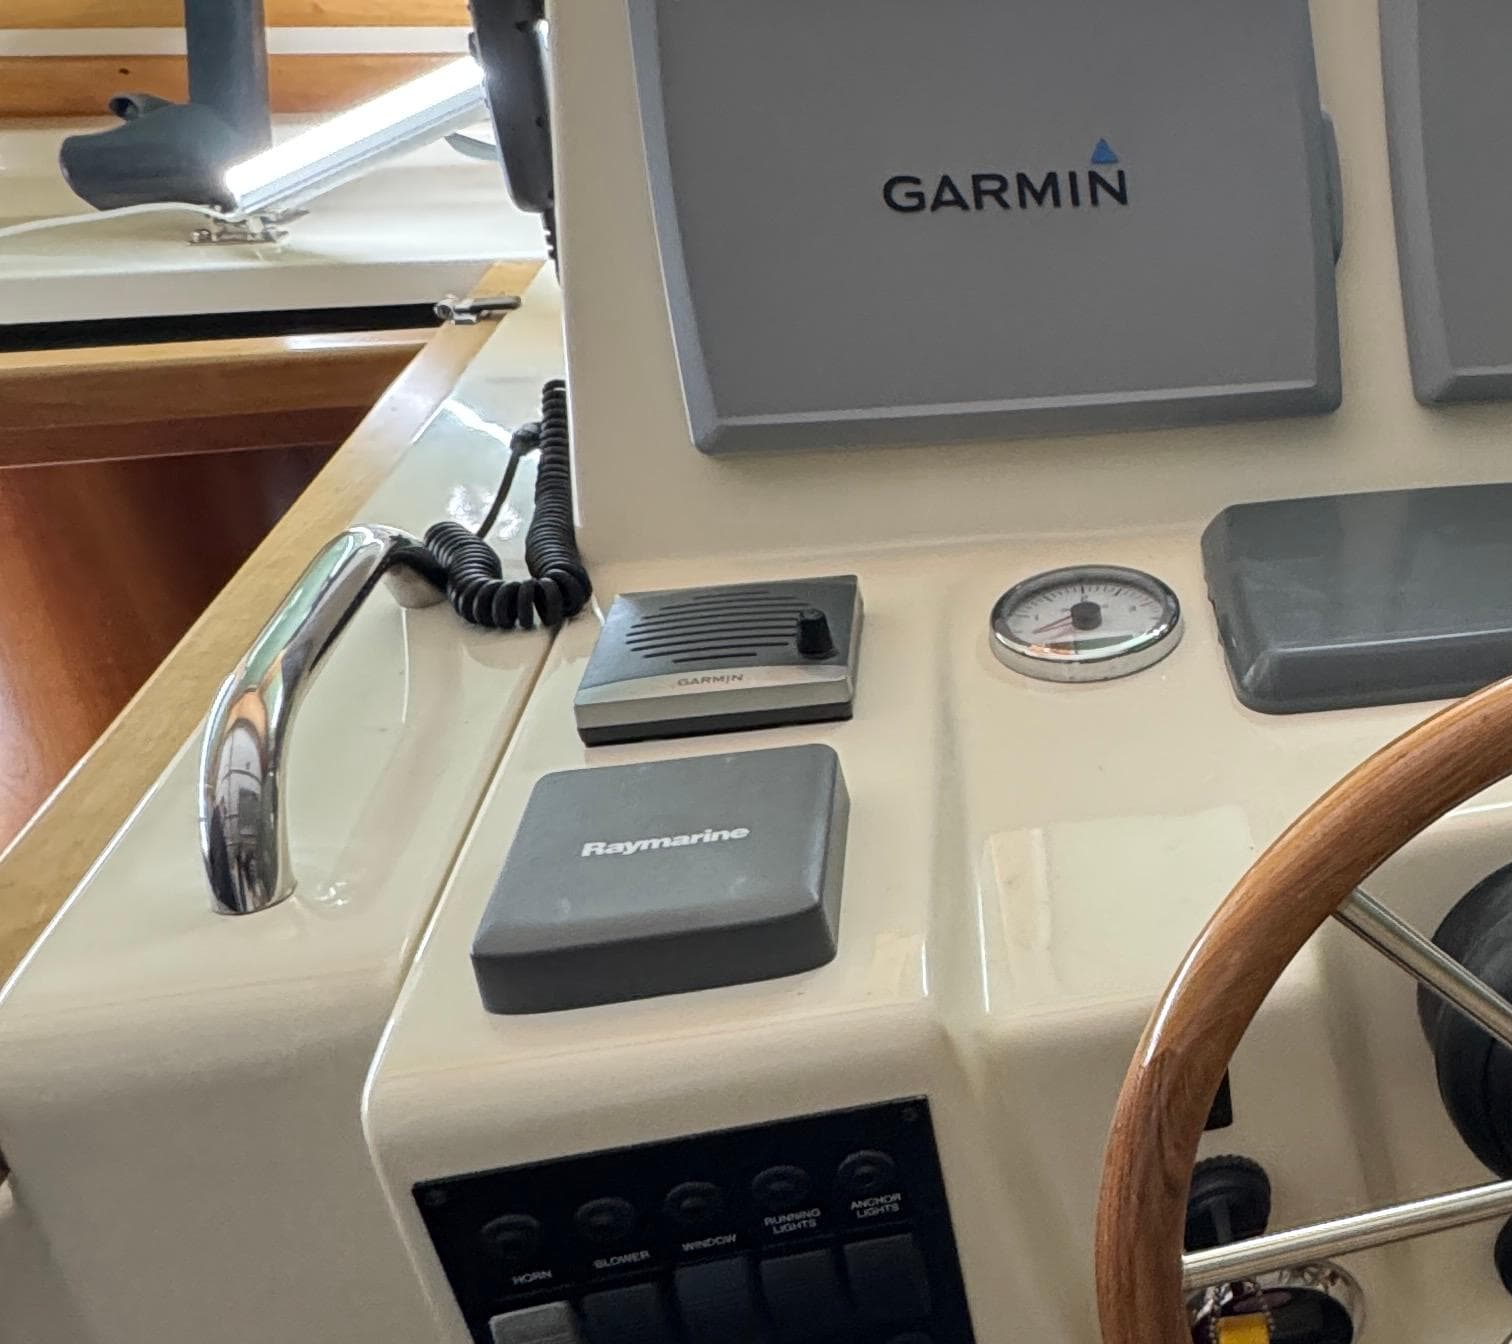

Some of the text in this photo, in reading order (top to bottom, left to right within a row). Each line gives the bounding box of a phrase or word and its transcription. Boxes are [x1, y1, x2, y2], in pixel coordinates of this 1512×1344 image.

[882, 169, 1129, 214] GARMIN
[677, 673, 744, 687] GARMIN
[580, 826, 751, 858] Raymarine
[851, 1192, 902, 1211] ANCHOR
[856, 1202, 900, 1219] LIGHTS
[763, 1207, 822, 1227] RUNNING
[771, 1217, 818, 1235] LIGHTS
[681, 1233, 738, 1253] WINDOW
[593, 1249, 651, 1270] BLOWER
[511, 1269, 553, 1286] HORN
